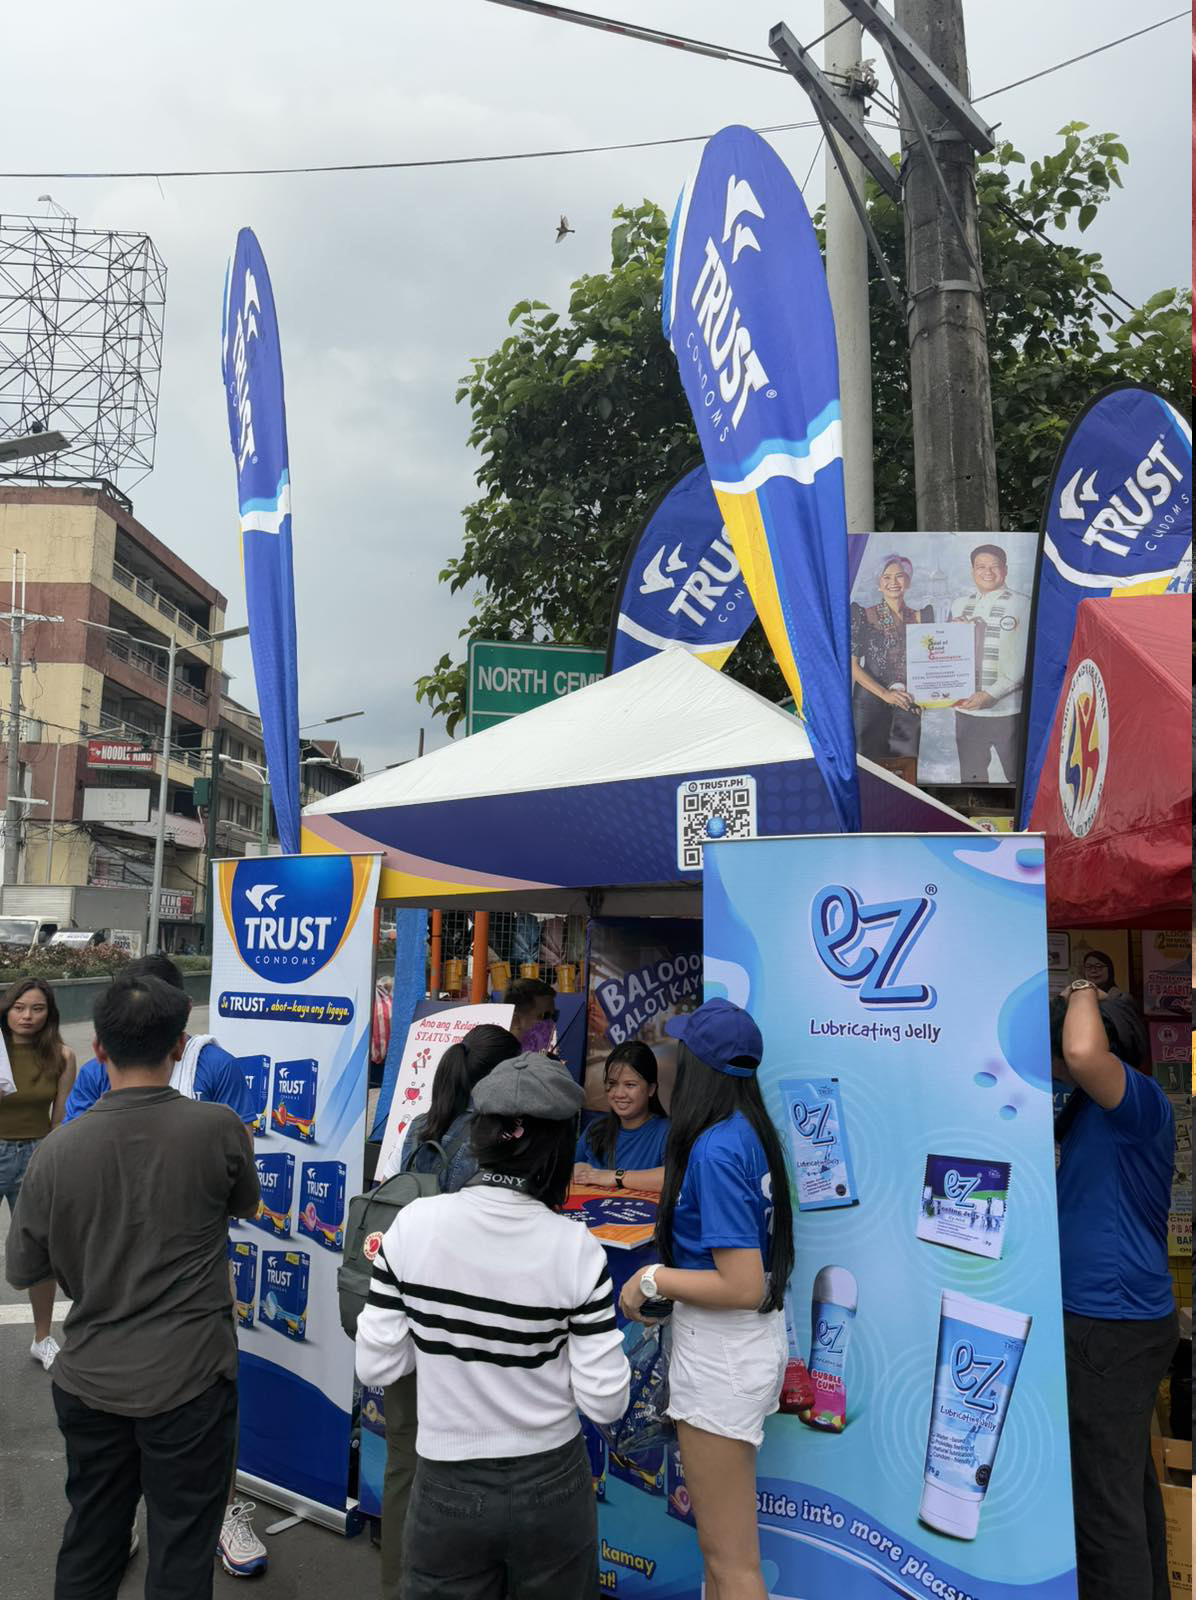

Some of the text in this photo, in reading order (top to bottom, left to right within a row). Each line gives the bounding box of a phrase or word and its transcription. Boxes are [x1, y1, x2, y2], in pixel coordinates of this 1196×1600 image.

[692, 237, 769, 430] TRUST
[1081, 439, 1184, 558] TRUST
[667, 524, 741, 627] TRU
[477, 665, 547, 694] NORTH
[101, 745, 131, 760] NOODLE
[699, 778, 744, 791] TRUST.PH
[244, 916, 332, 951] TRUST
[255, 955, 316, 966] CONDOMS
[602, 953, 702, 1018] BALOOO
[311, 1006, 324, 1019] ang
[609, 975, 703, 1045] BALOT KAY
[419, 1018, 436, 1028] Ano
[436, 1021, 451, 1031] ang
[809, 1019, 901, 1042] Lubricating
[414, 1031, 451, 1043] STATUS
[278, 1080, 305, 1095] TRUST
[307, 1180, 330, 1198] TRUST
[481, 1172, 527, 1188] SONY
[266, 1269, 293, 1288] TRUST
[811, 1368, 842, 1386] BUBBLE
[816, 1380, 836, 1393] GUM
[940, 1404, 980, 1425] Lubricating
[802, 1501, 845, 1529] into
[849, 1517, 904, 1561] more
[602, 1540, 655, 1577] kamay
[599, 1571, 617, 1590] at!
